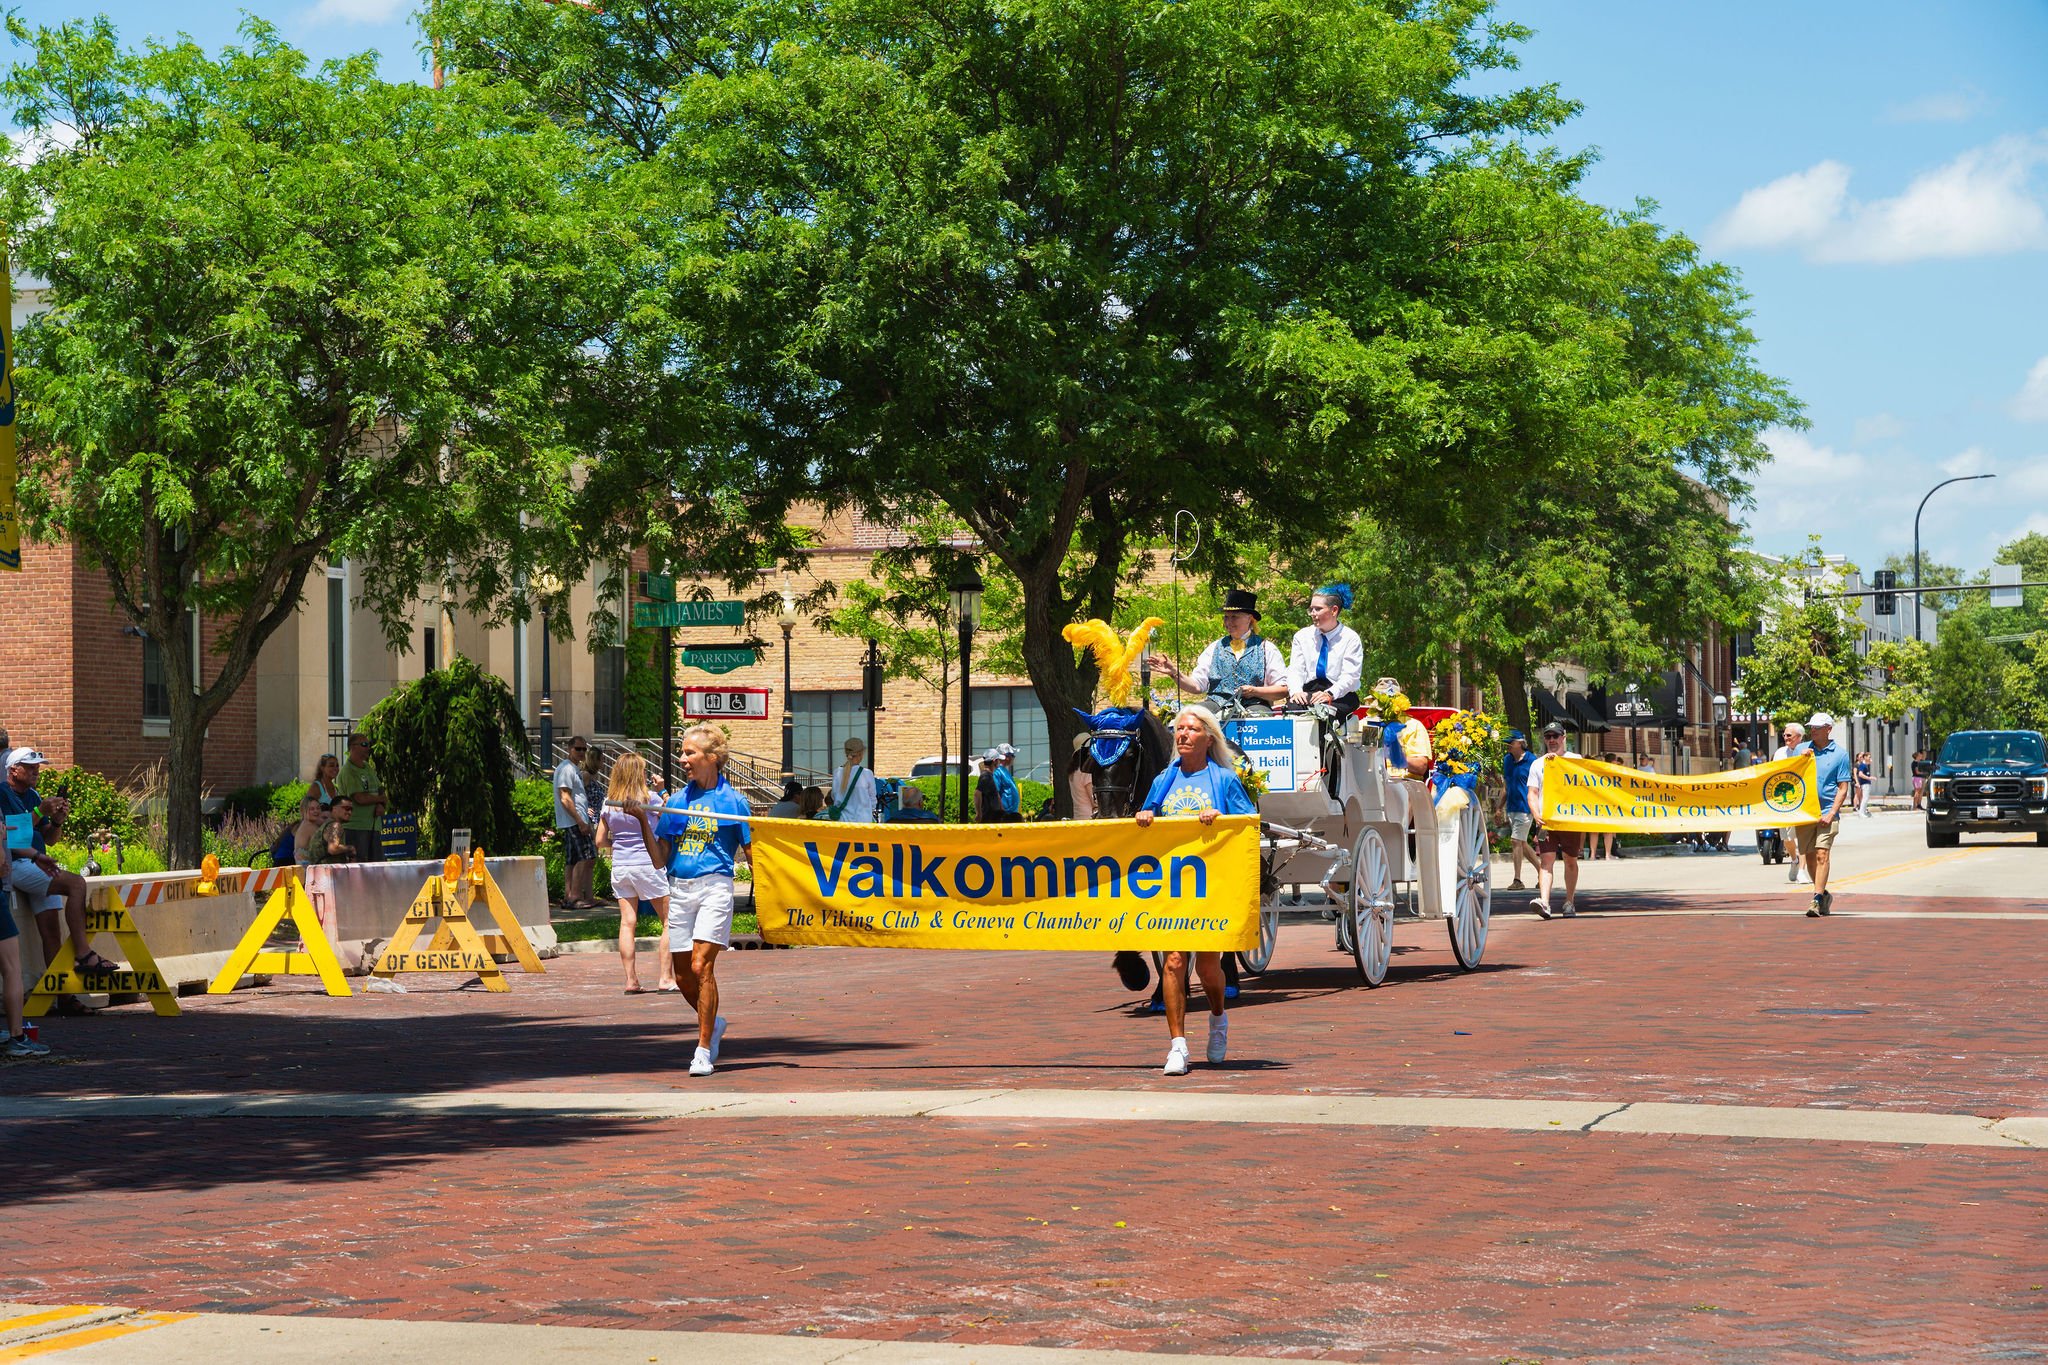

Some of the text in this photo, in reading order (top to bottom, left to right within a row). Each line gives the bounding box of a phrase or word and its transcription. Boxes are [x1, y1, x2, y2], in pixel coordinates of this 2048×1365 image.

[677, 602, 723, 624] JAMES
[725, 603, 733, 612] ST
[691, 653, 745, 664] PARKING
[1237, 725, 1258, 735] 2025
[1243, 735, 1292, 746] Marshals
[1259, 756, 1289, 767] Heidi
[1564, 773, 1748, 791] MAYOR KEVIN BURNS
[1635, 793, 1676, 802] and the
[1557, 803, 1623, 817] GENEVA
[1631, 805, 1668, 817] CITY
[1677, 804, 1756, 817] COUNCIL
[394, 826, 414, 834] FOOD
[804, 841, 1207, 899] Välkommen
[167, 880, 186, 900] CITY
[413, 901, 455, 918] CITY
[85, 910, 124, 930] CITY
[786, 908, 1229, 933] The Viking Club & Geneva Chamber of Commerce
[387, 952, 486, 971] OF GENEVA
[44, 972, 160, 992] OF GENEVA
